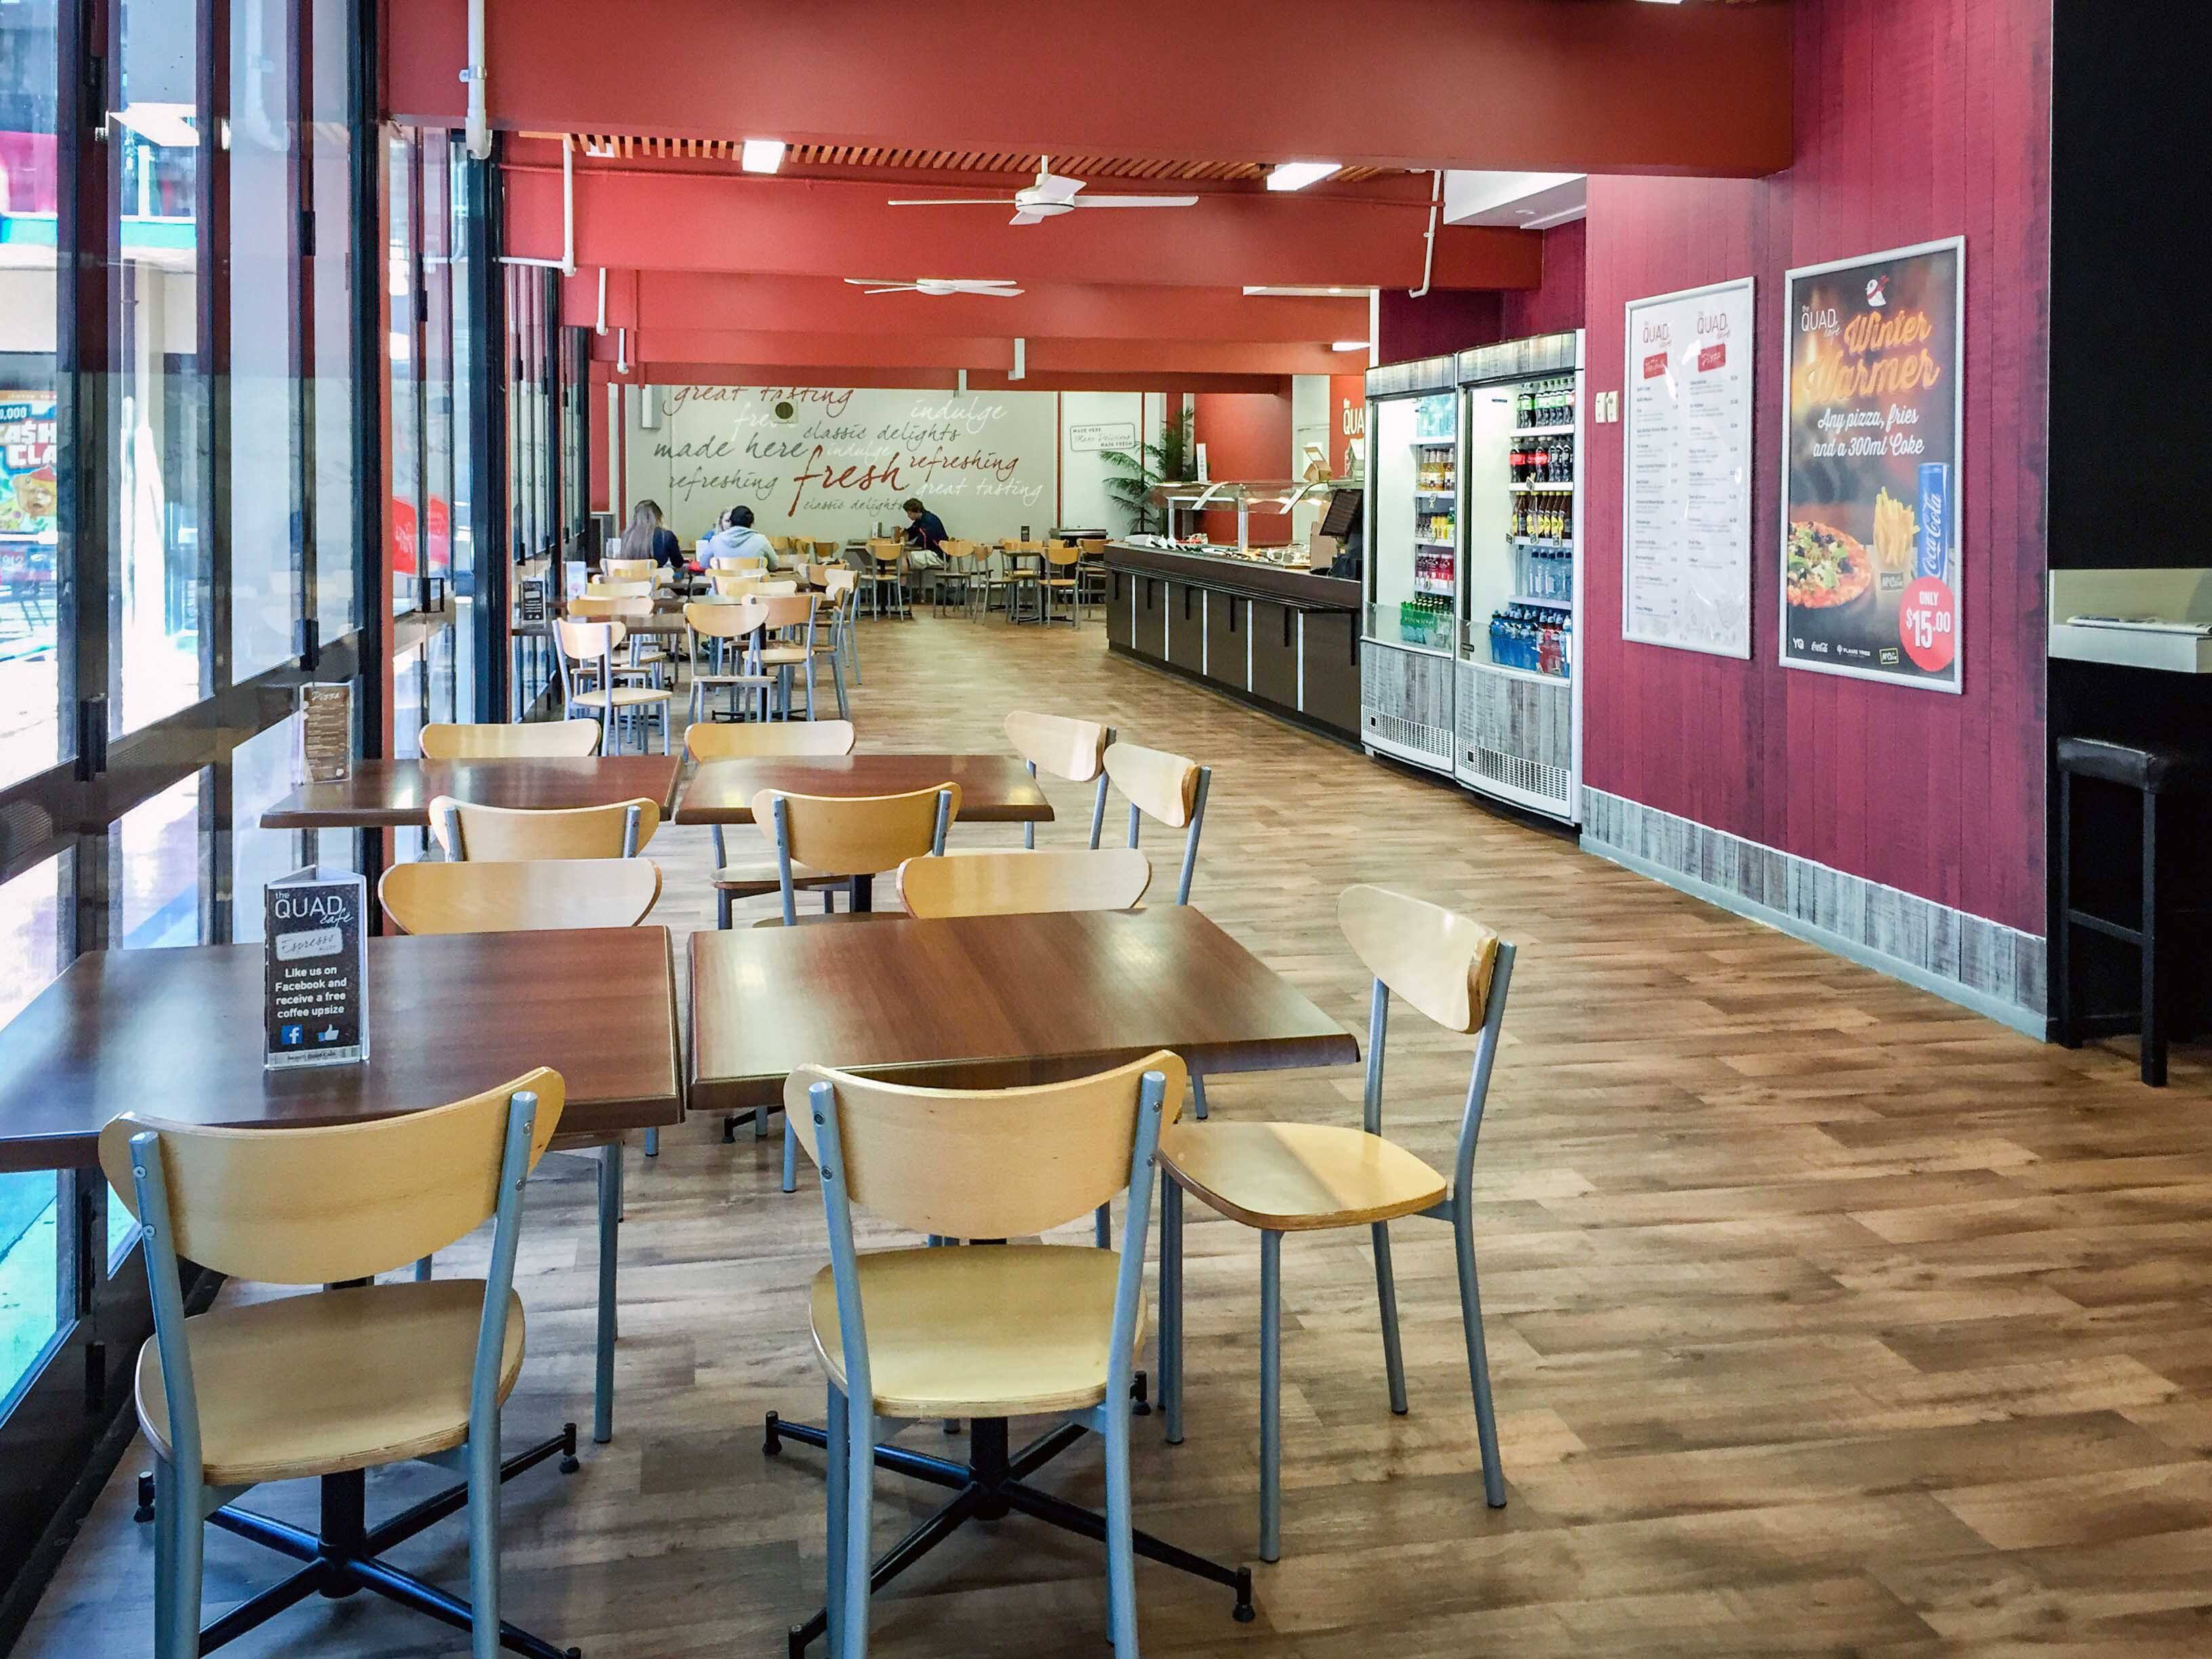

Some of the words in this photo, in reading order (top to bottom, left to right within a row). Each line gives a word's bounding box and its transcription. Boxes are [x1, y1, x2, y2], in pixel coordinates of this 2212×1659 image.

[1697, 313, 1727, 334] QUAD
[1801, 308, 1836, 331] QUAD
[1844, 310, 1932, 354] Winter
[1643, 324, 1670, 343] QUAD
[1805, 348, 1940, 402] Warmer
[663, 386, 747, 415] great
[761, 387, 854, 417] tasting
[731, 401, 798, 442] fre
[910, 396, 1009, 433] indulge
[1818, 407, 1845, 434] Any
[1845, 408, 1884, 432] pizza,
[1885, 403, 1919, 432] fries
[654, 435, 735, 458] made
[746, 432, 808, 458] here
[803, 420, 867, 439] classic
[877, 421, 961, 451] delights
[1813, 439, 1836, 457] and
[1837, 443, 1847, 457] a
[1847, 436, 1887, 457] 300ml
[1889, 432, 1925, 456] Coke
[826, 441, 893, 466] indulge
[910, 446, 1019, 482] refreshing
[670, 466, 778, 500] refreshing
[788, 445, 910, 517] fresh
[907, 477, 969, 504] great
[977, 478, 1044, 506] tasting
[803, 496, 844, 510] classic
[1919, 590, 1939, 607] ONLY
[1906, 607, 1950, 649] $15.00
[275, 895, 342, 919] QUAD
[276, 891, 290, 899] the
[281, 935, 334, 954] Espresso
[275, 979, 326, 992] Facebook
[328, 977, 348, 988] and
[285, 968, 308, 978] Like
[309, 968, 322, 976] us
[276, 994, 314, 1005] receive
[316, 994, 323, 1002] a
[325, 992, 346, 1002] free
[277, 1008, 310, 1019] coffee
[312, 1005, 345, 1017] upsize
